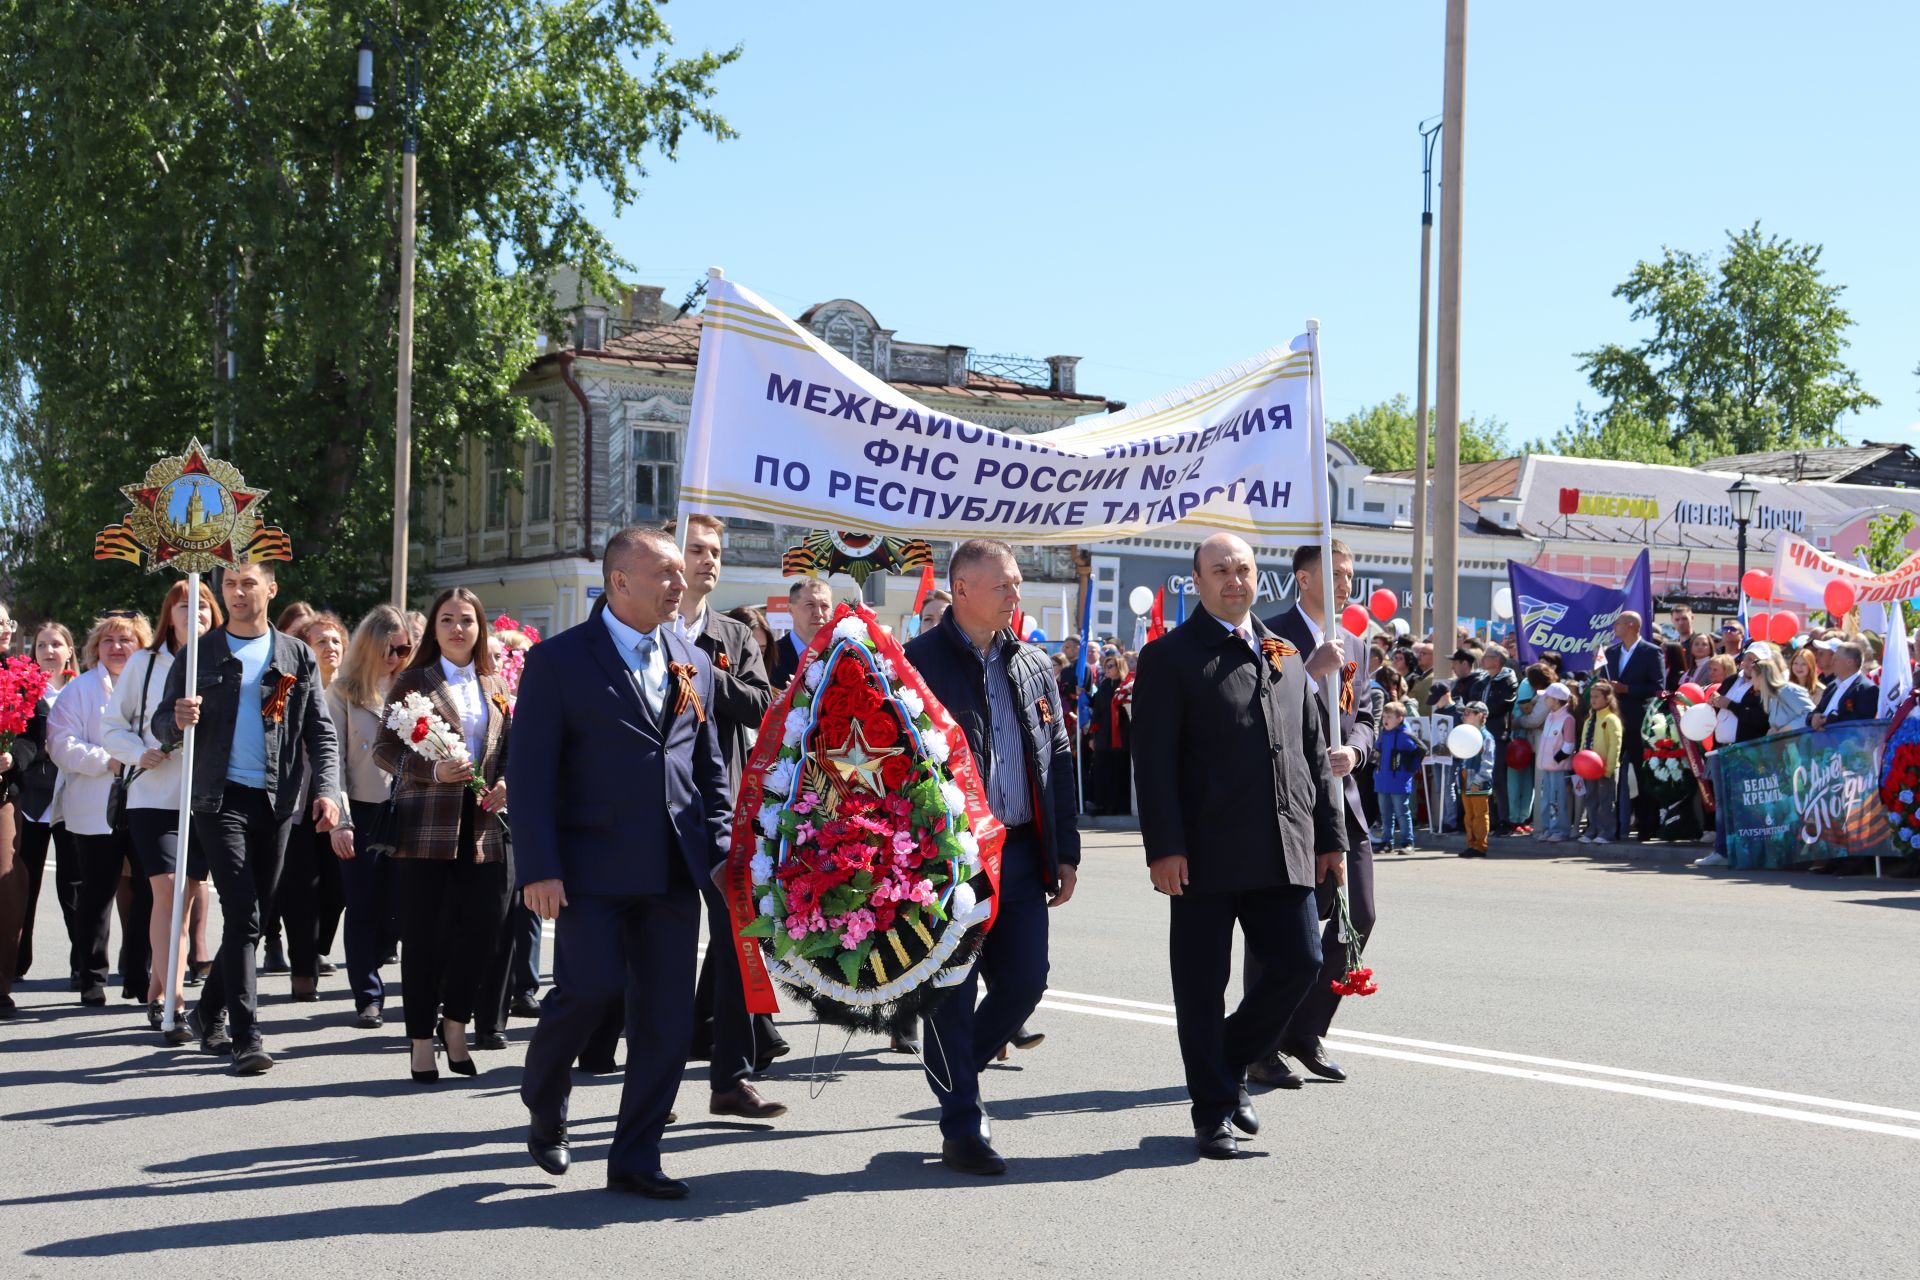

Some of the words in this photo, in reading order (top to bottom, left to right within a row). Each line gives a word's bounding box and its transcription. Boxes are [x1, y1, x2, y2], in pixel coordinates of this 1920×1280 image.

[767, 373, 1087, 459] МЕЖРАЙО
[863, 438, 959, 488] ФНС
[973, 458, 1130, 493] РОССИИ
[1140, 456, 1204, 491] №12
[753, 453, 811, 492] ПО
[828, 468, 1088, 526] РЕСПУБЛИКЕ
[1103, 478, 1292, 525] ТАТАРСТАН
[1675, 499, 1757, 529] Леген
[176, 536, 219, 550] ПОБЕДА
[1742, 789, 1783, 806] КРЕМЛЬ
[1743, 773, 1779, 792] БЕЛЫЙ
